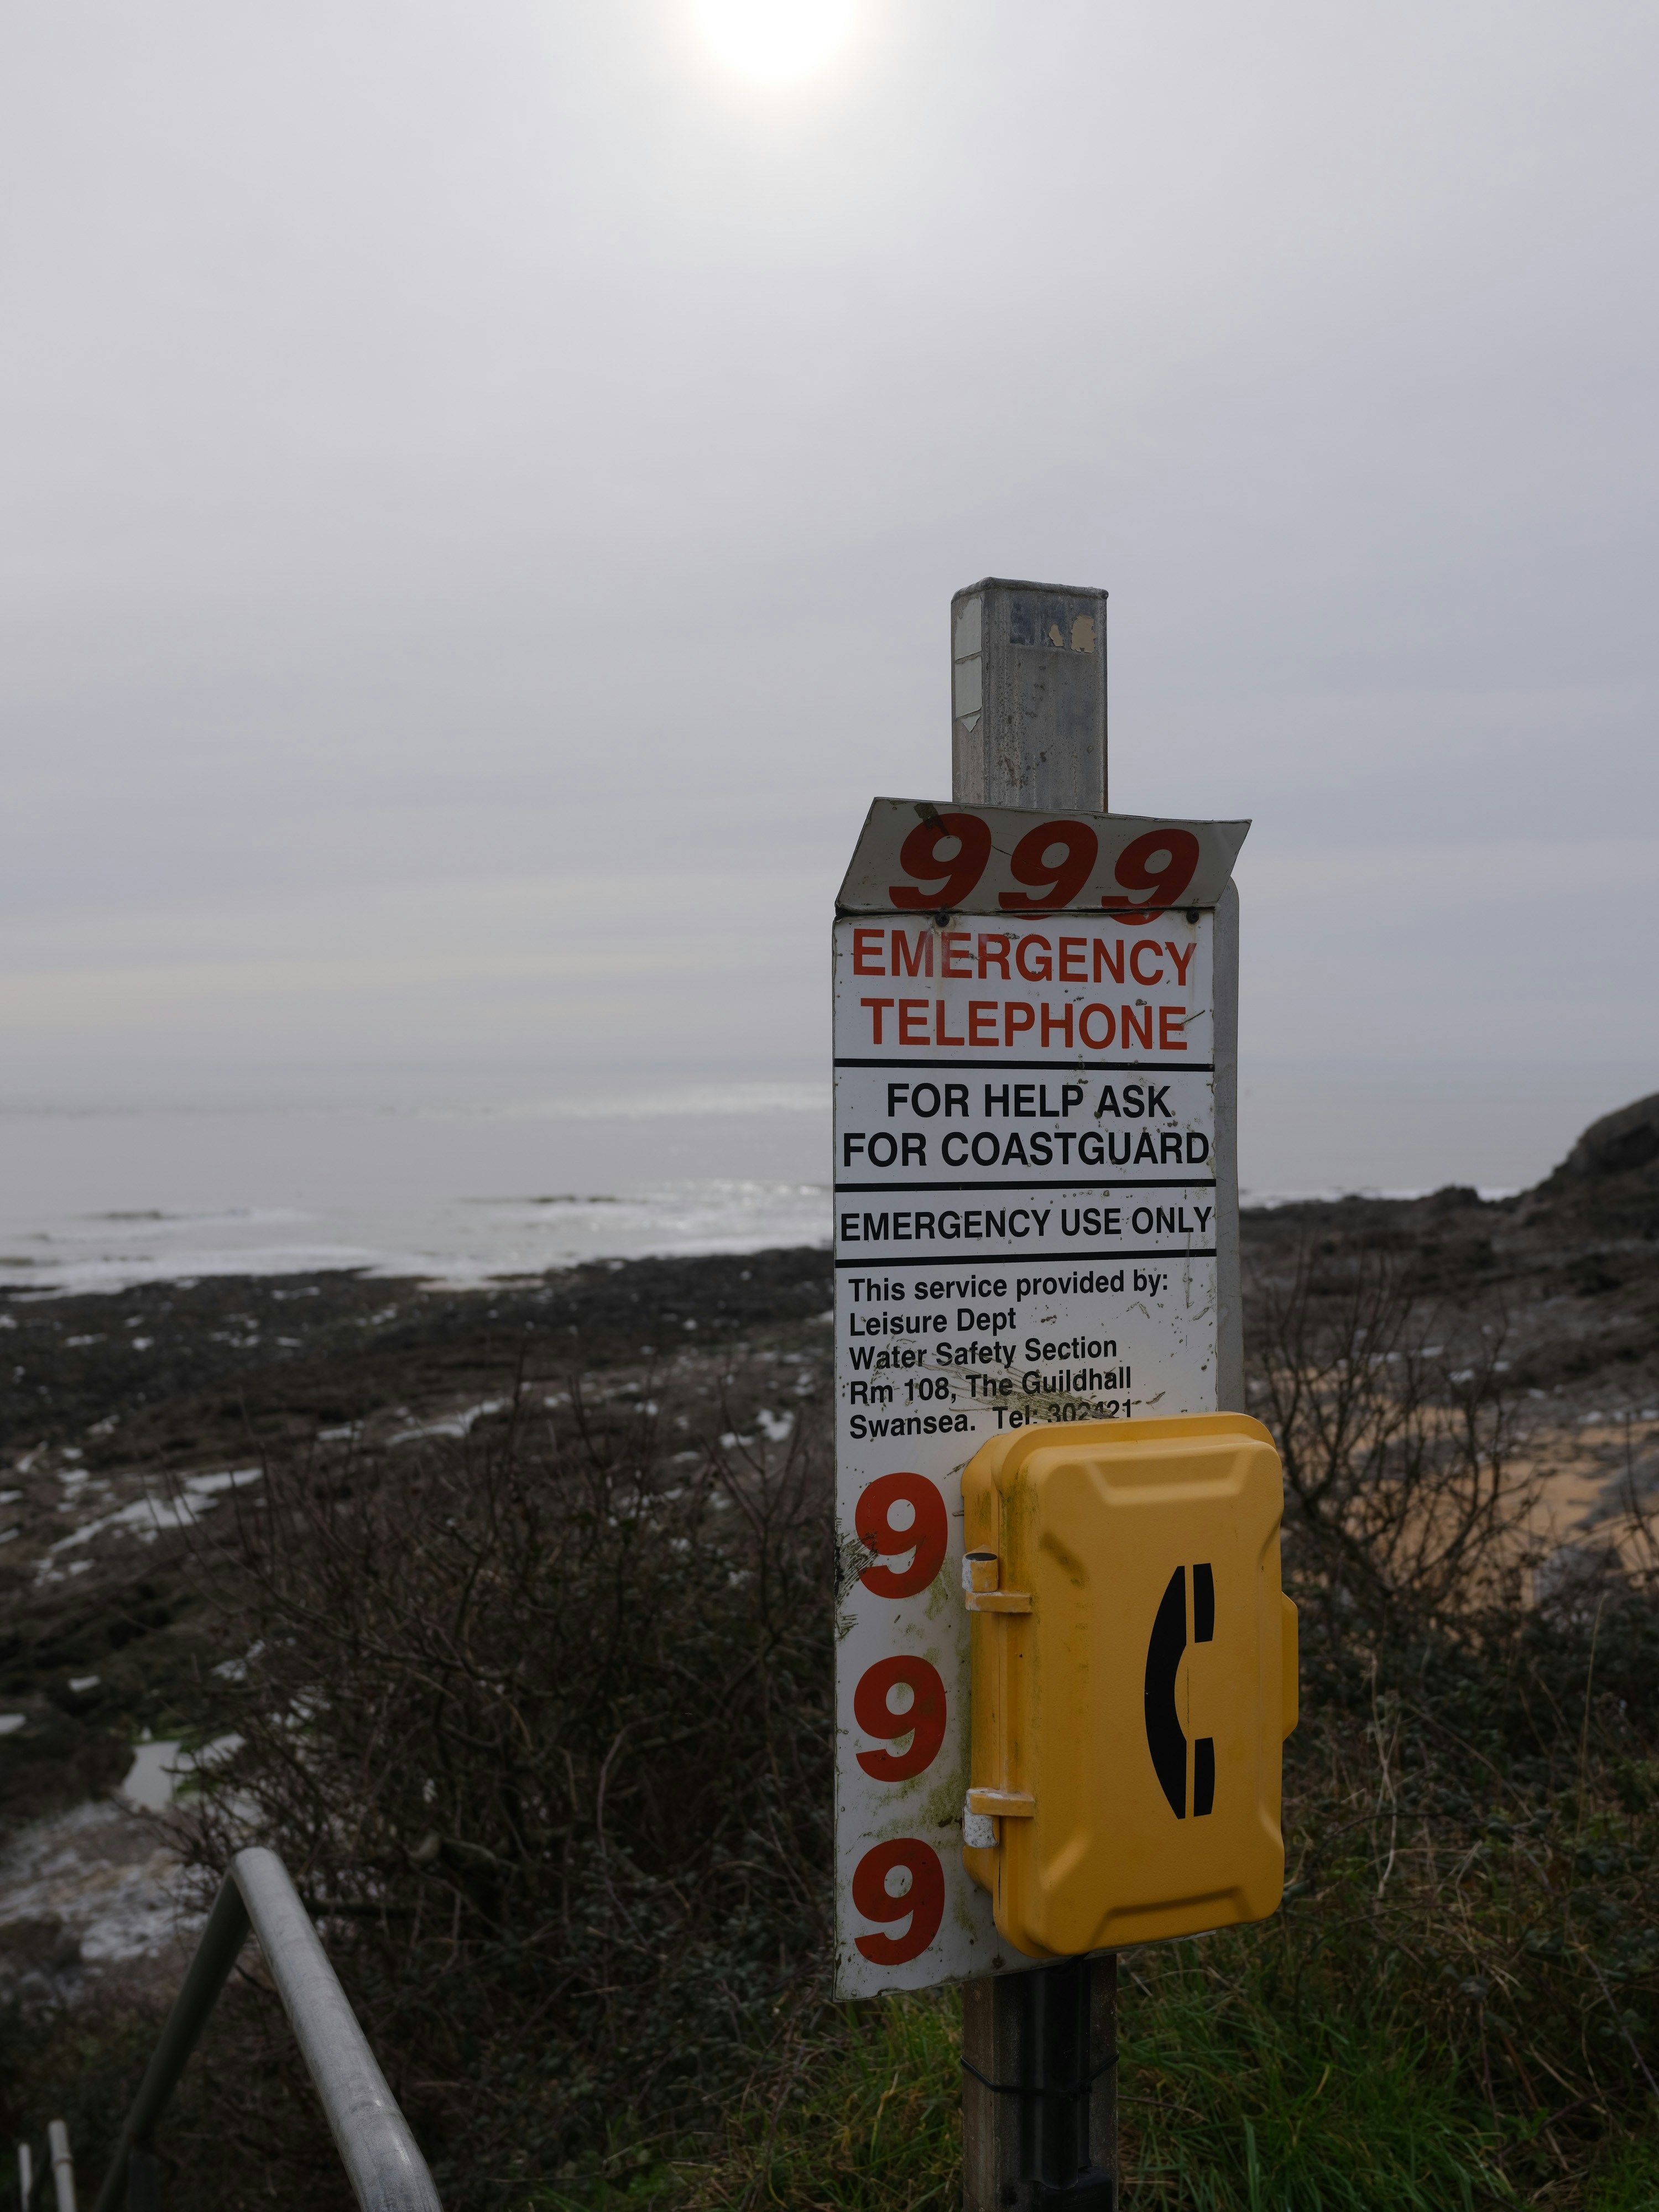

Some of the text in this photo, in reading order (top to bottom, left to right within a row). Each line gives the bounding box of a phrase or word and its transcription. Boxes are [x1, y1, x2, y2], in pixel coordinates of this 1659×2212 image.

[889, 813, 1199, 925] 999
[853, 928, 1197, 986] EMERGENCY
[861, 998, 1187, 1050] TELEPHONE
[888, 1083, 1172, 1118] FOR HELP ASK
[844, 1131, 1209, 1167] FOR COASTGUARD
[842, 1207, 1212, 1241] EMERGENCY USE ONLY
[848, 1270, 1168, 1302] This service provided by:
[851, 1308, 1016, 1336] Leisure Dept
[849, 1338, 1116, 1370] Water Safety Section
[851, 1366, 1131, 1404] Rm 108, The Guildhall
[850, 1413, 975, 1439] Swansea.
[992, 1405, 1037, 1428] Tel:
